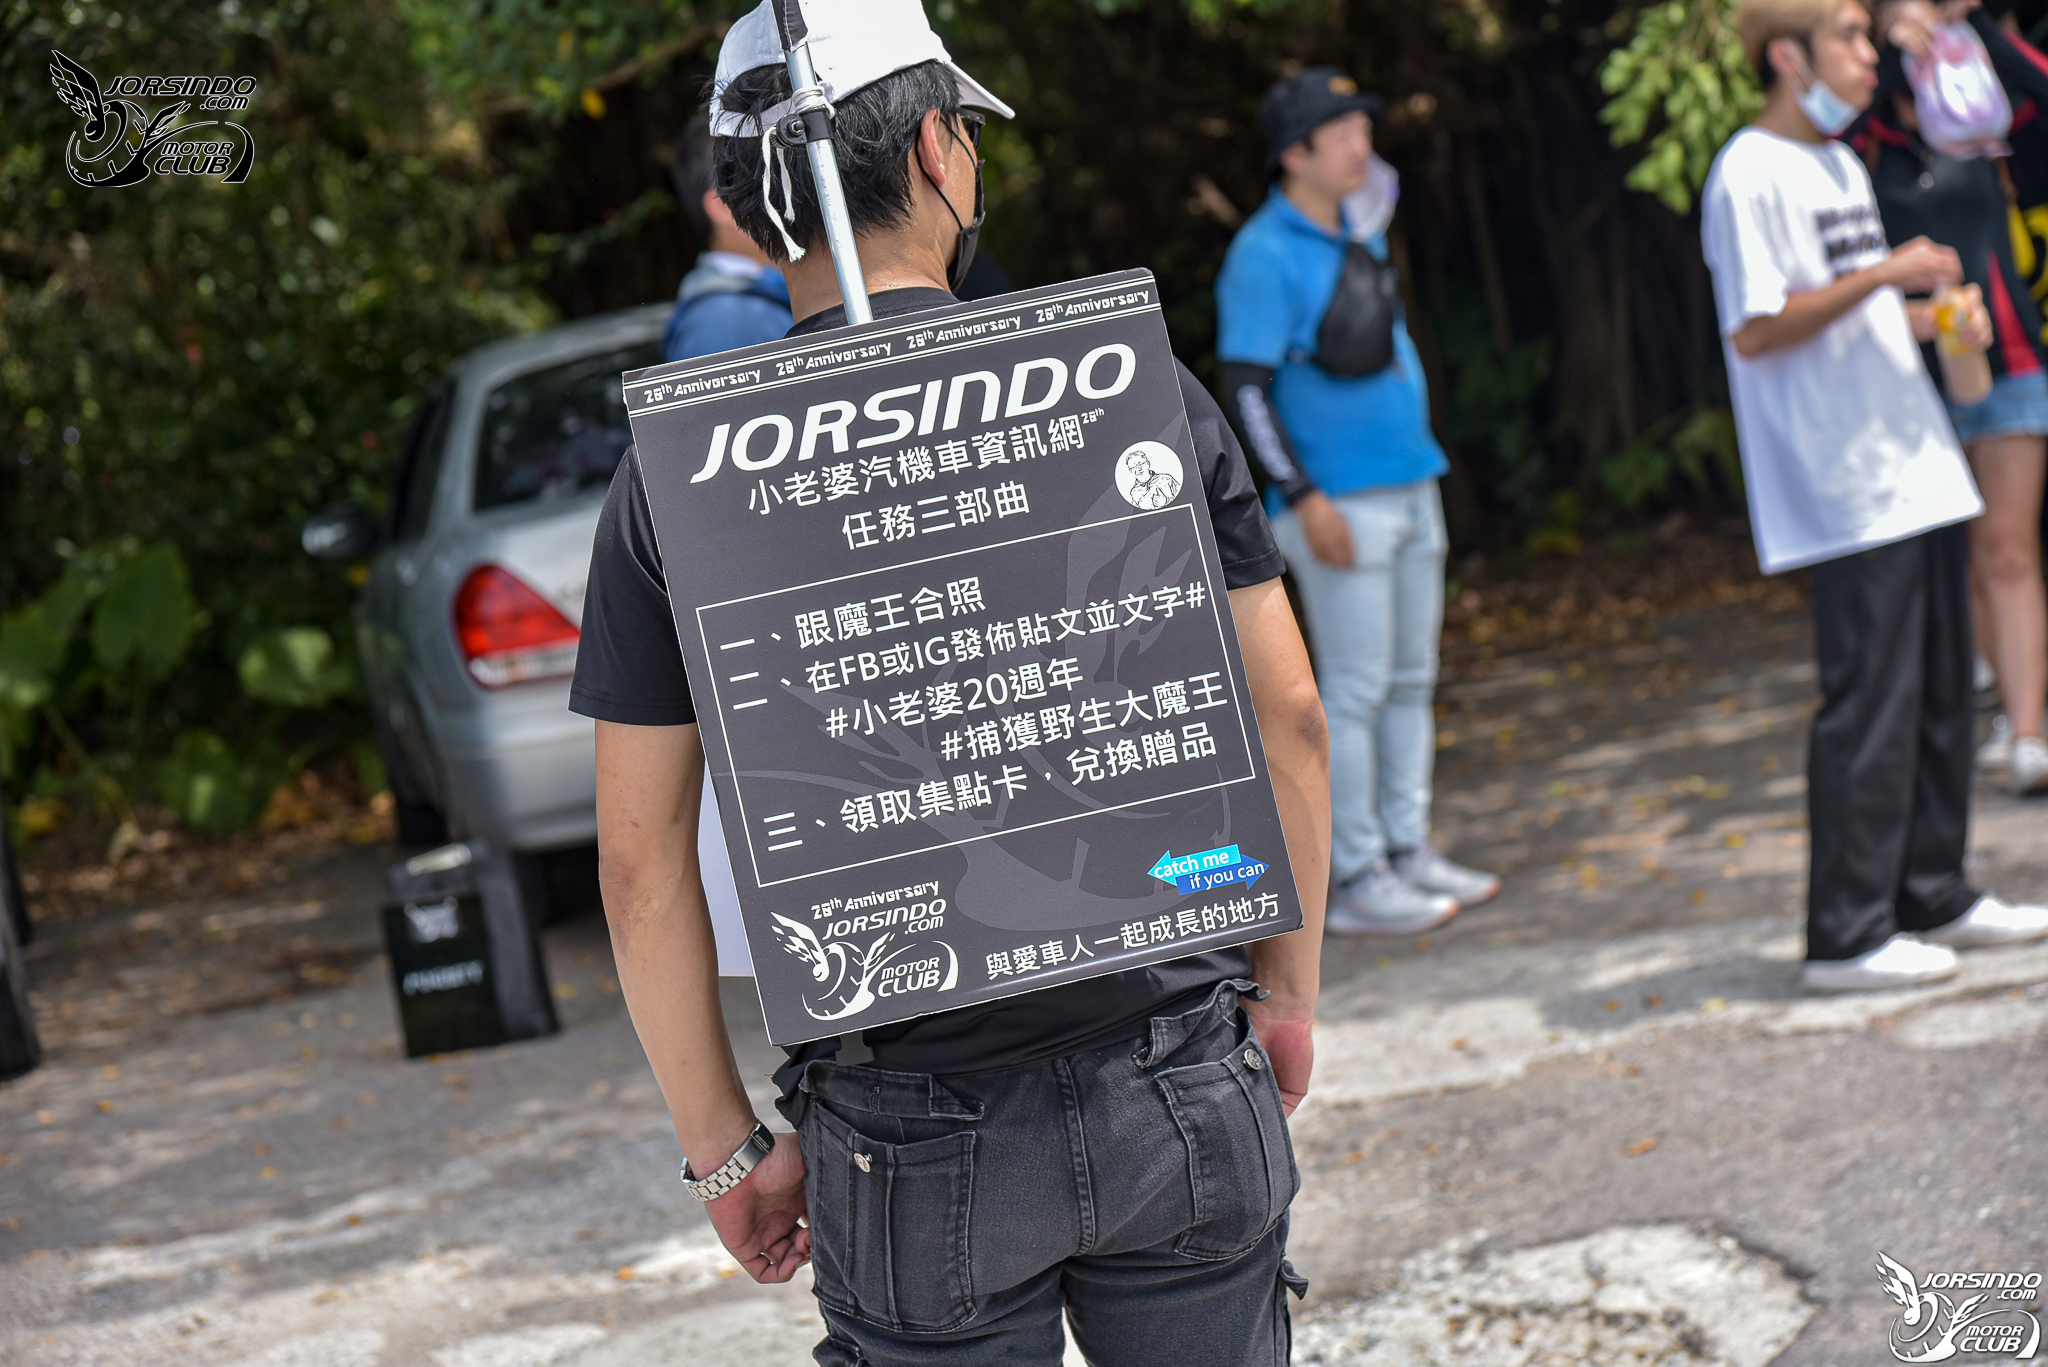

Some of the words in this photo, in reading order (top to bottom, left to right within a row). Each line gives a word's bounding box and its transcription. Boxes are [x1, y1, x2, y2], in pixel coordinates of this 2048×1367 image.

[674, 369, 761, 397] Anniversary
[805, 342, 892, 370] Anniversary
[936, 316, 1021, 343] Anniversary
[1065, 290, 1149, 317] Anniversary
[689, 343, 1137, 484] JORSINDO
[748, 414, 1085, 516] 小老婆汽機車資訊網
[841, 481, 1030, 551] 任務三部曲
[825, 657, 1084, 739] #小老婆20週年
[940, 671, 1228, 762] #捕獲野生大魔王
[844, 881, 939, 912] Anniversary
[1154, 855, 1199, 879] catch
[1203, 852, 1229, 868] me
[1189, 873, 1201, 889] if
[1204, 870, 1234, 890] you
[1237, 863, 1265, 878] can
[822, 898, 947, 940] JORSINDO
[985, 892, 1279, 981] 與愛車人一起成長的地方
[877, 970, 940, 998] CLUB
[881, 957, 940, 980] MOTOR
